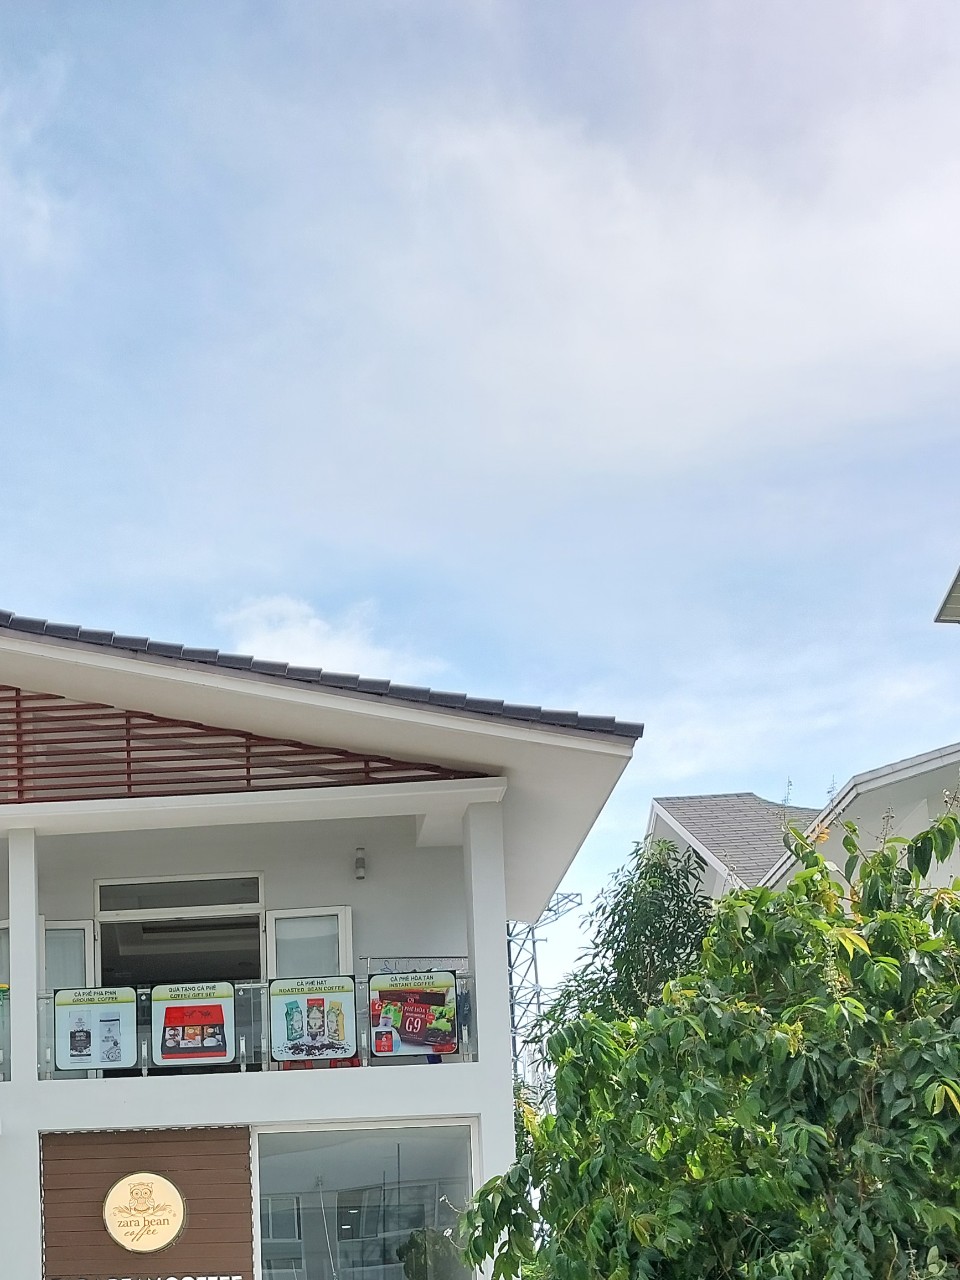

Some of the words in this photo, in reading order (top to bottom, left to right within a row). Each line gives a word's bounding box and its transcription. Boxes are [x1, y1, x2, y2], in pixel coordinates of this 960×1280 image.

[406, 1017, 421, 1032] G9
[143, 1217, 169, 1227] bean
[124, 1225, 158, 1242] coffee
